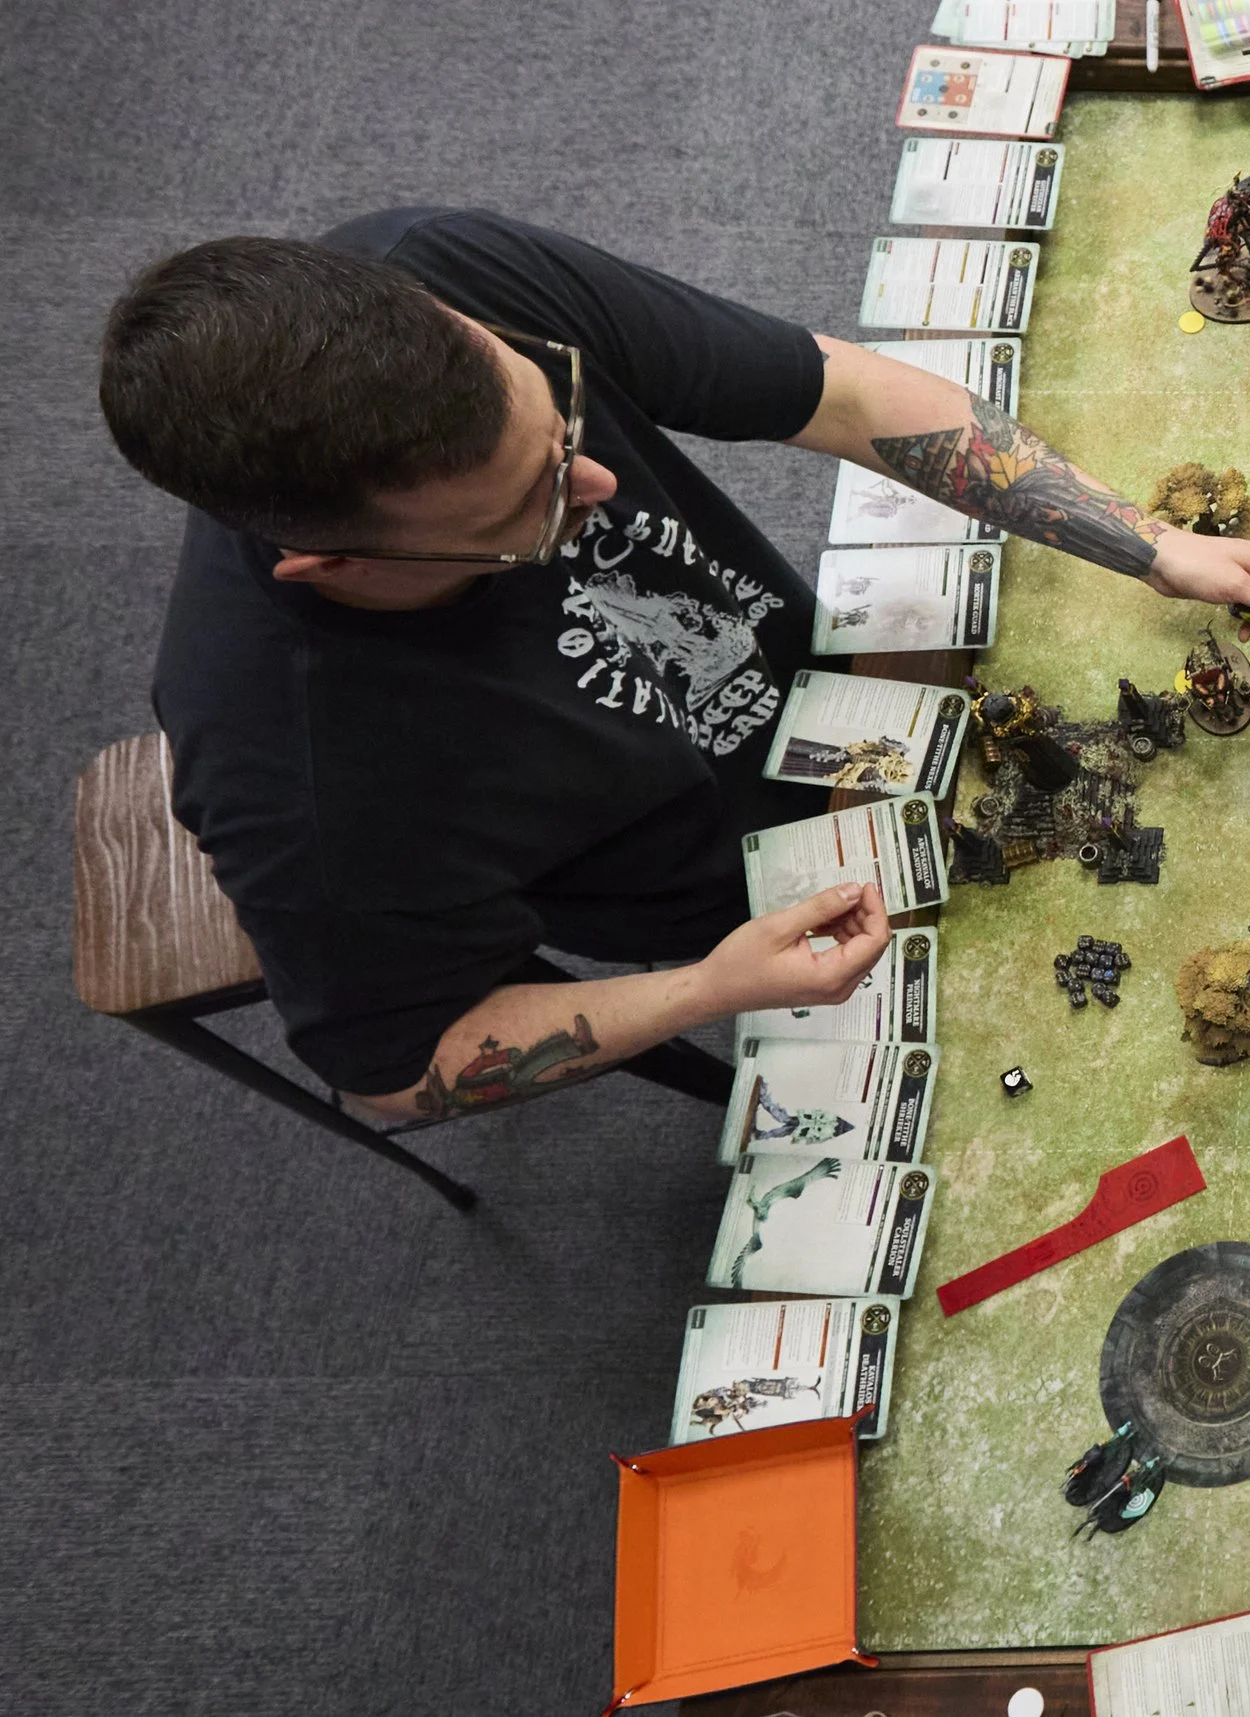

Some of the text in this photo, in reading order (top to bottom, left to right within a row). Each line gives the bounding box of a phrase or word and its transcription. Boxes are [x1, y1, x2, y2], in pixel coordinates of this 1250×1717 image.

[905, 984, 914, 1024] PREDATOR
[912, 979, 921, 1027] NIGHTMARE
[894, 1102, 907, 1142] SHRIEKER
[887, 1226, 902, 1266] CARRION
[892, 1217, 912, 1277] SOULSTEALER
[865, 1365, 875, 1404] KAVALOS
